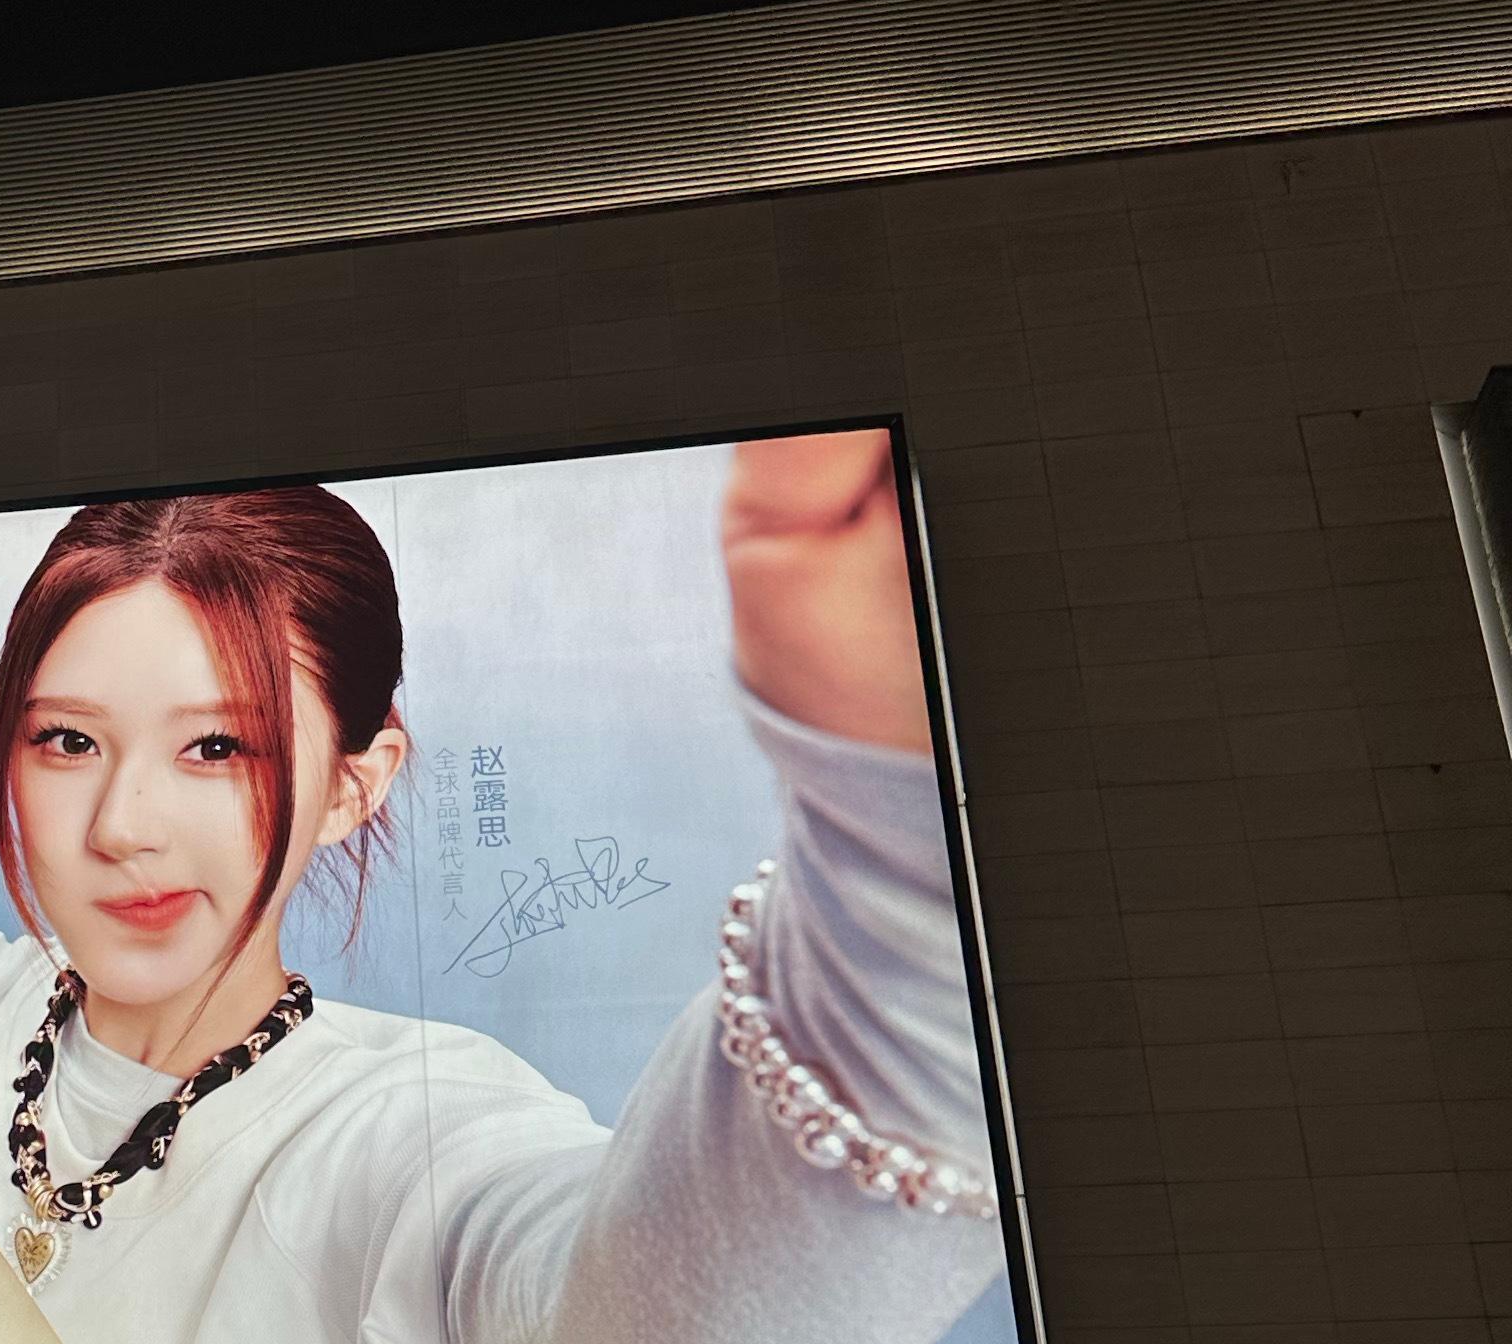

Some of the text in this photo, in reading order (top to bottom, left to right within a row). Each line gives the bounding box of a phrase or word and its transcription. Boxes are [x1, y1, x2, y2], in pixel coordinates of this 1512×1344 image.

[433, 747, 469, 922] 全球品牌代言人
[470, 745, 512, 849] 赵露思
